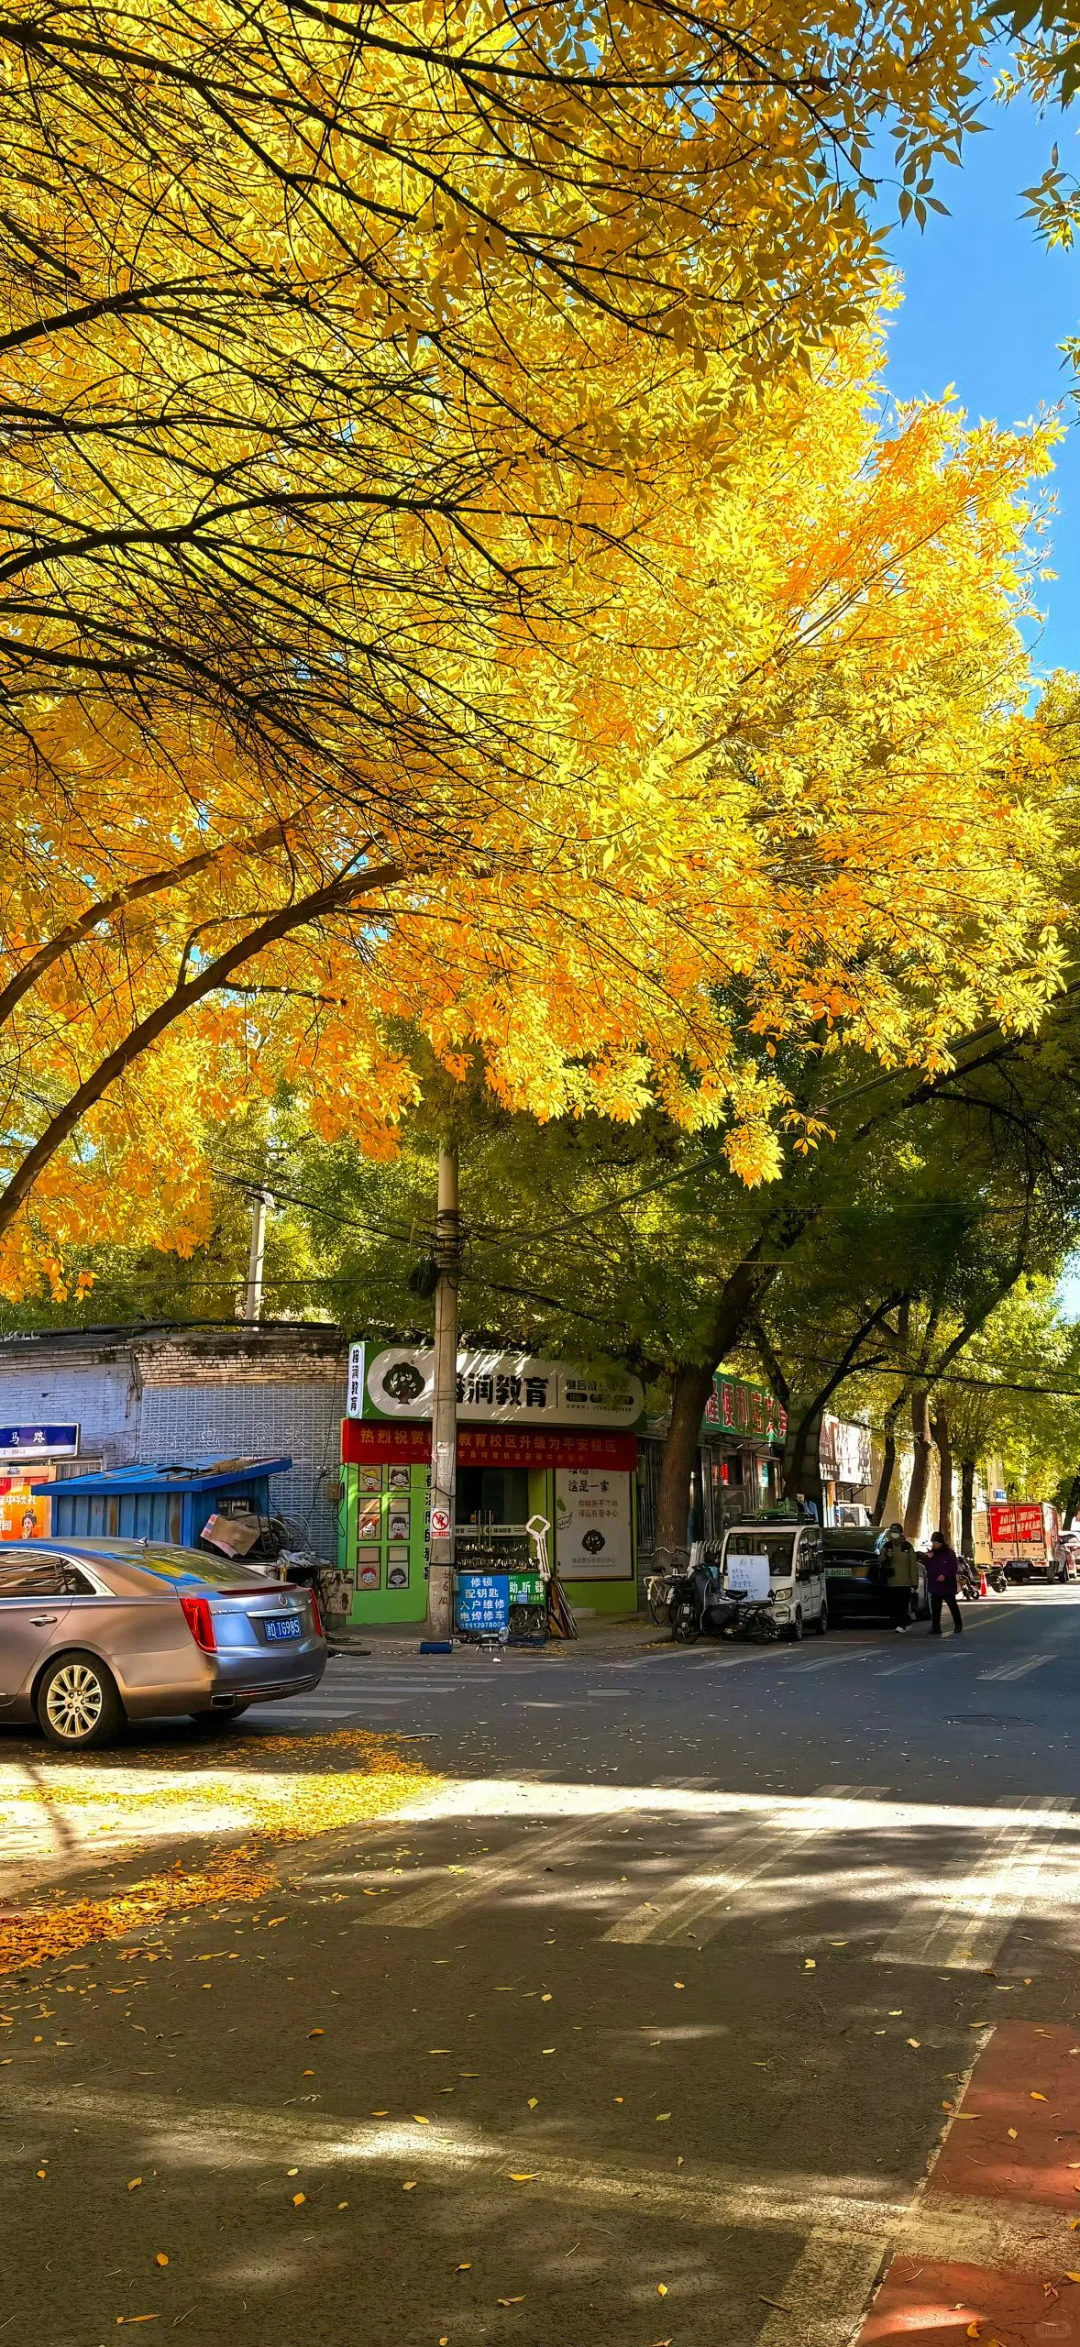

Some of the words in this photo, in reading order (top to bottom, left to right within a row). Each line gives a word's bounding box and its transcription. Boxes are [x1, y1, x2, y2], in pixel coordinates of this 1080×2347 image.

[568, 1480, 610, 1492] 这是一家
[471, 1577, 493, 1587] 修锁
[465, 1588, 499, 1599] 配钥匙
[460, 1599, 505, 1610] 入户维修
